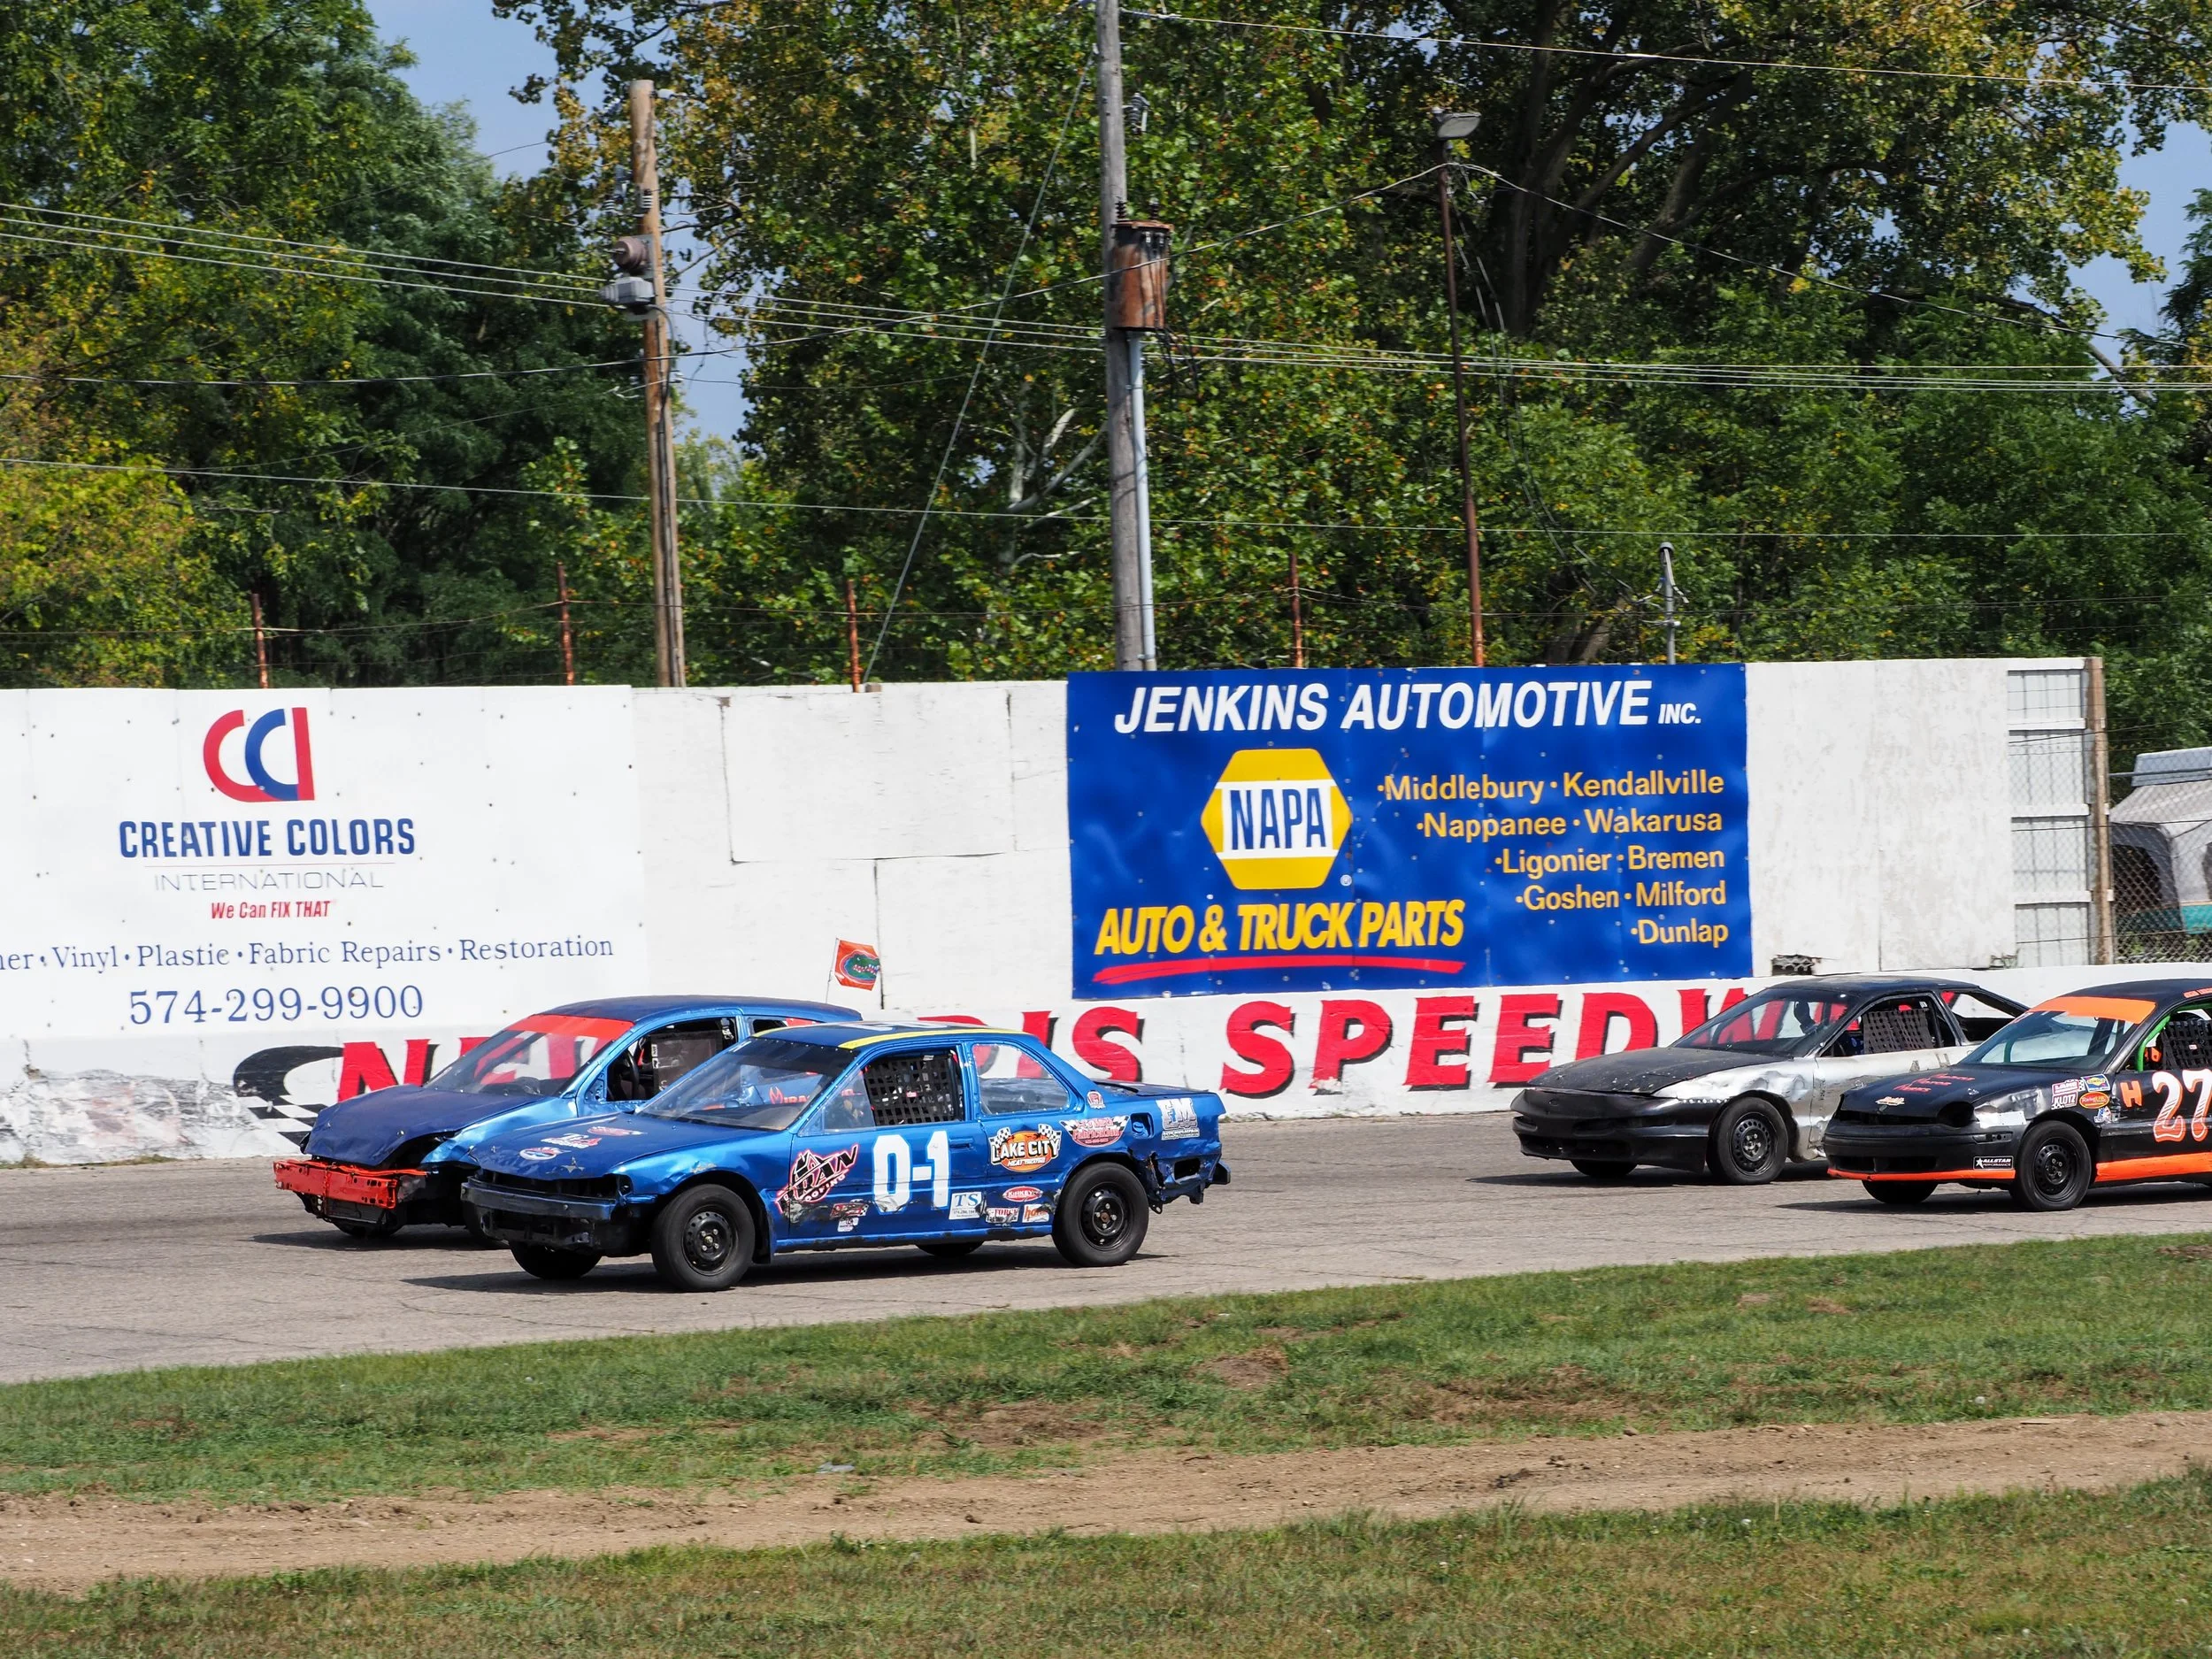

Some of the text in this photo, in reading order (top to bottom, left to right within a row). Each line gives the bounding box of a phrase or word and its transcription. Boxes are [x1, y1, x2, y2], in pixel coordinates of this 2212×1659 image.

[1114, 680, 1702, 733] JENKINS AUTOMOTIVE INC.
[1384, 769, 1724, 804] Middlebury Kendallville
[1229, 787, 1327, 850] NAPA
[1423, 808, 1723, 843] Nappanee Wakarusa
[119, 818, 415, 858] CREATIVE COLORS
[1502, 845, 1725, 879] Ligonier Bremen
[154, 871, 384, 891] INTERNATIONAL
[1522, 880, 1726, 911] Goshen Milford
[211, 900, 332, 919] We Can FIX THAT
[1094, 899, 1467, 956] AUTO & TRUCK PARTS
[1637, 918, 1729, 949] Dunlap
[51, 945, 119, 974] Vinyl
[137, 942, 230, 967] Plastic
[249, 941, 330, 965] Fabric
[341, 939, 442, 969] Repairs
[458, 934, 615, 961] Restoration
[130, 985, 424, 1025] 574-299-9900
[2054, 1093, 2076, 1106] KLOTZ
[2120, 1080, 2143, 1108] H
[991, 1141, 1026, 1164] LAKE
[1028, 1139, 1060, 1157] CITY
[872, 1130, 949, 1212] 0-1
